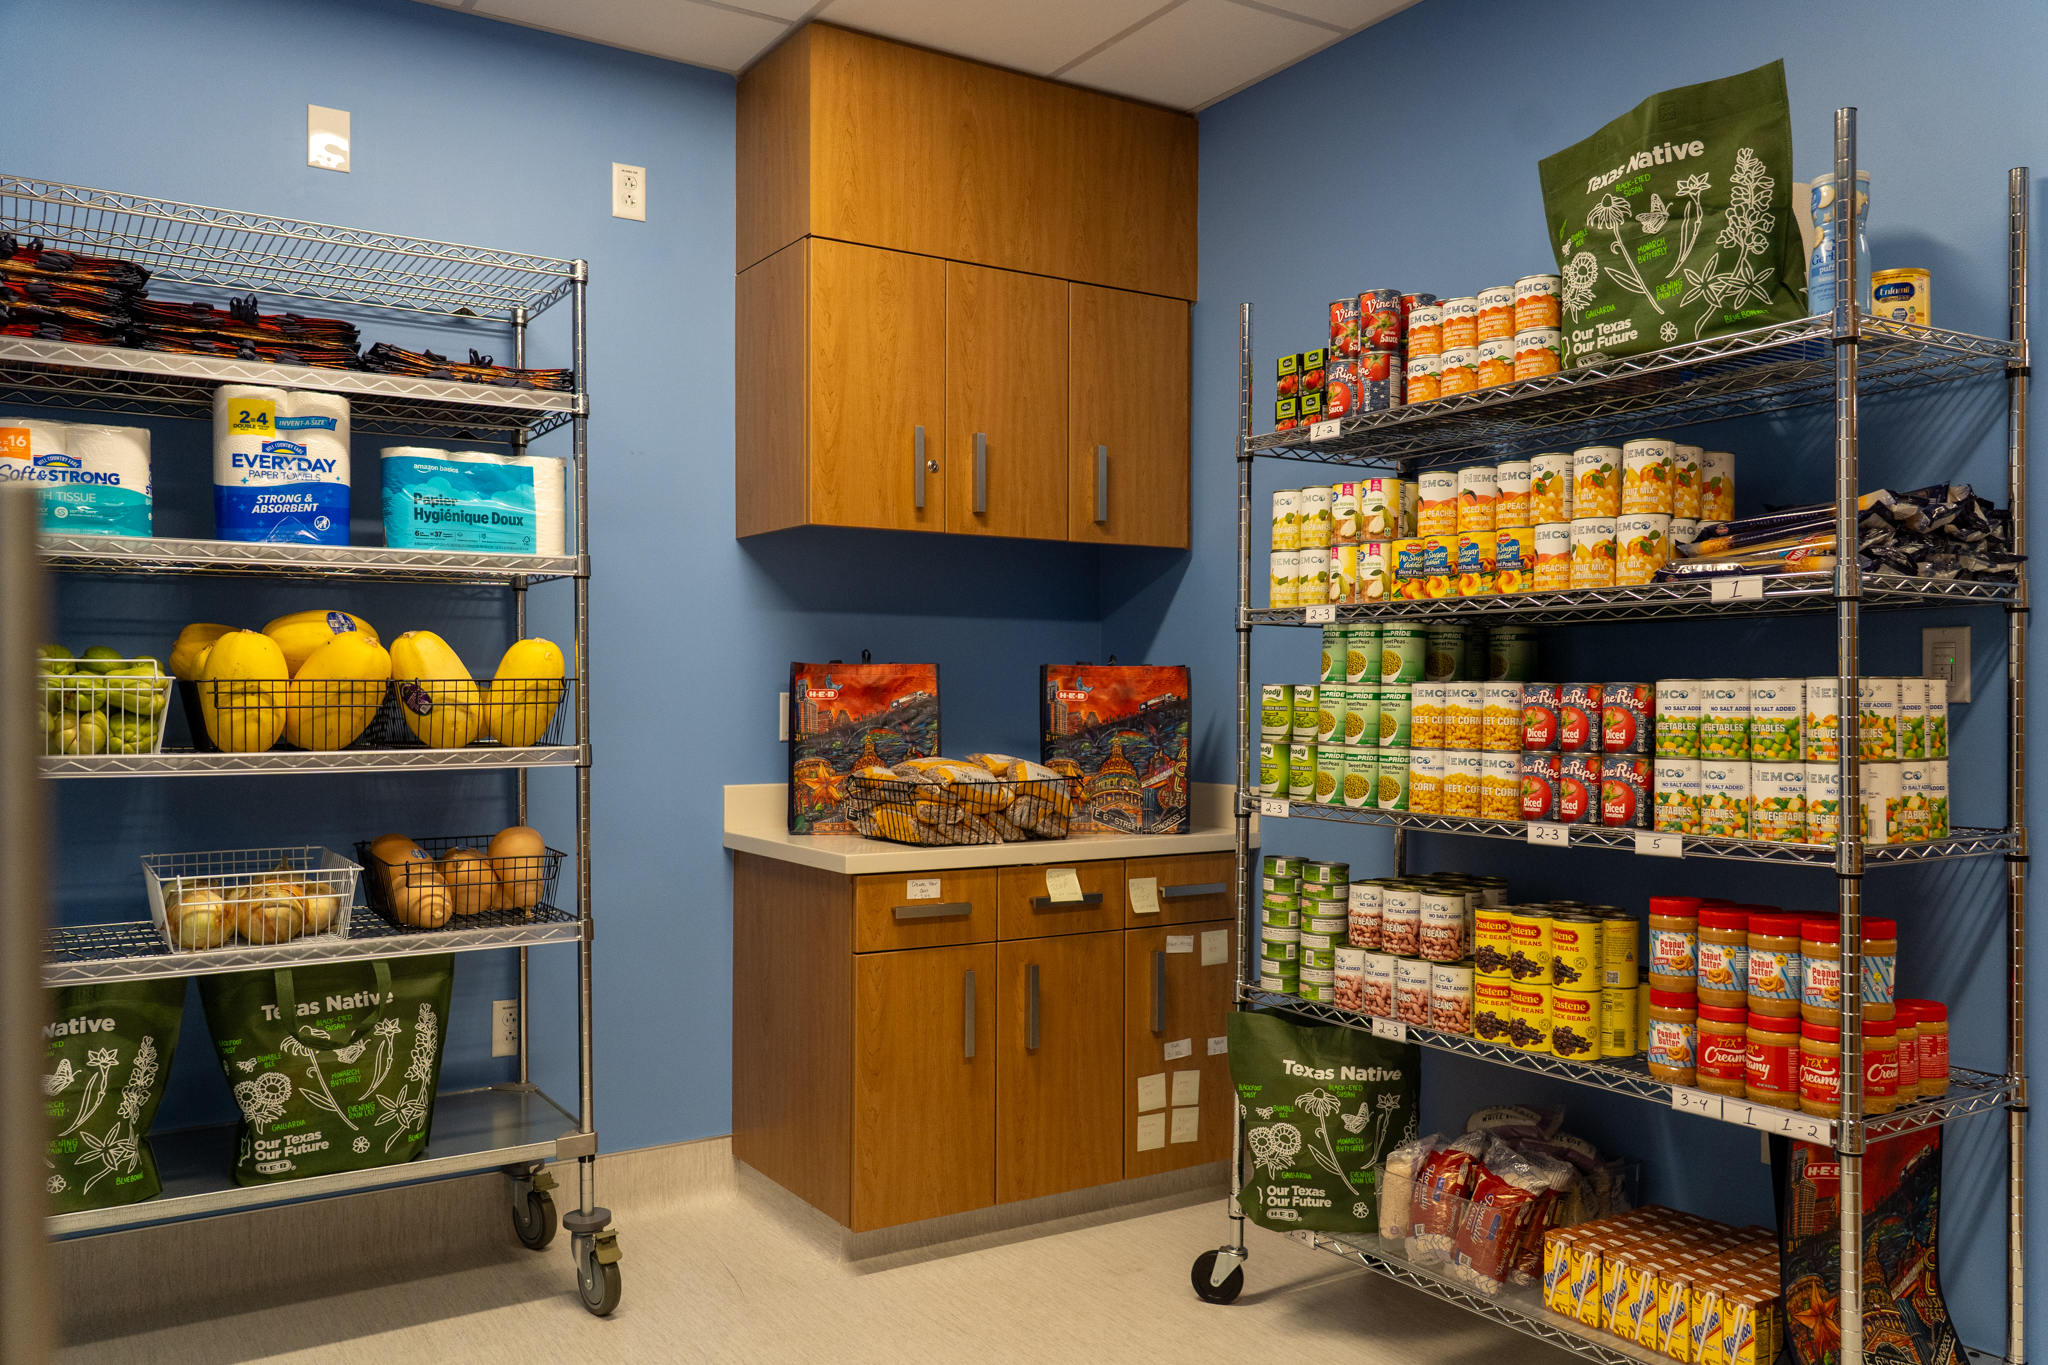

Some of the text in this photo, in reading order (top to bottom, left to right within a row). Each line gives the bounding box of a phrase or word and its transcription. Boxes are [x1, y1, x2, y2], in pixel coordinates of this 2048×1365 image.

[1585, 140, 1704, 195] Texas Native
[1615, 173, 1651, 192] BLACK-EYED
[1623, 184, 1643, 198] SUSAN
[1571, 228, 1588, 243] BUMBLE
[1637, 237, 1666, 255] MONARCH
[1637, 245, 1668, 264] BUTTERFLY
[1655, 278, 1683, 295] EVENING
[1879, 285, 1910, 296] Enfamil
[1655, 286, 1683, 301] RAIN LILY
[1366, 299, 1390, 314] Vine
[1522, 302, 1548, 311] MANDARIN
[1523, 308, 1549, 316] SEGMENTS
[1484, 319, 1508, 327] SEGMENTS
[1571, 319, 1631, 343] Our Texas
[1380, 334, 1398, 344] Sauce
[1596, 328, 1638, 351] Future
[1336, 366, 1358, 382] Ripe
[1328, 405, 1343, 414] Sauce
[279, 419, 325, 427] INVENT-A-SIZE
[266, 441, 304, 455] HILL COUNTRY FARE
[37, 458, 47, 466] HILL
[67, 457, 79, 467] FARE
[232, 453, 337, 473] EVERYDAY
[0, 464, 120, 485] Soft STRONG
[413, 463, 459, 474] amazon basics
[248, 469, 321, 482] PAPER TOWELS
[56, 491, 96, 503] TISSUE
[1624, 486, 1654, 496] FRUIT MIX
[256, 493, 313, 504] STRONG &
[413, 492, 458, 507] Papier
[251, 503, 319, 514] ABSORBENT
[1427, 510, 1456, 518] PEACHES
[1461, 506, 1480, 514] DICED
[414, 507, 524, 527] Hygiénique Doux
[1773, 515, 1797, 523] Quality
[1276, 526, 1298, 534] PEARS
[1308, 523, 1331, 531] PEARS
[1399, 554, 1407, 563] No
[1428, 550, 1447, 563] Sugar
[1404, 561, 1423, 569] Added
[1573, 564, 1590, 572] FRUIT
[1729, 580, 1743, 599] 1
[1262, 688, 1281, 697] Foody
[1570, 689, 1598, 709] Ripe
[1617, 689, 1645, 709] Ripe
[1457, 716, 1481, 725] CORN
[1497, 716, 1522, 726] CORN
[1527, 727, 1547, 738] Diced
[1562, 728, 1579, 739] Diced
[1606, 729, 1626, 740] Diced
[1164, 795, 1184, 806] FEST
[1114, 817, 1141, 831] STREET
[1152, 813, 1181, 832] CONGRESS
[1652, 838, 1662, 850] 5
[1476, 919, 1507, 931] Pastene
[1660, 938, 1685, 949] Peanut
[1661, 947, 1685, 957] Butter
[1701, 950, 1722, 962] Peanut
[1701, 958, 1722, 969] Butter
[1476, 984, 1509, 997] Pastene
[1553, 998, 1586, 1011] Pastene
[315, 1014, 353, 1027] BLACK-EYED
[41, 1016, 115, 1039] Native
[325, 1022, 346, 1032] SUSAN
[1717, 1037, 1737, 1049] TEX
[257, 1052, 282, 1063] BUMBLE
[1805, 1057, 1823, 1069] TEX
[264, 1060, 276, 1068] BEE
[1282, 1059, 1402, 1081] Texas Native
[331, 1068, 360, 1080] MONARCH
[330, 1075, 362, 1088] BUTTERFLY
[1238, 1084, 1263, 1092] BLACKFOOT
[347, 1102, 376, 1114] EVENING
[348, 1110, 364, 1120] RAIN
[1482, 1114, 1503, 1123] WHITE
[1743, 1106, 1757, 1126] 1
[272, 1119, 306, 1132] GAILLARDIA
[254, 1131, 322, 1151] Our Texas
[254, 1139, 330, 1161] Our Future
[1350, 1176, 1364, 1184] RAIN
[1291, 1185, 1325, 1197] Texas
[1420, 1164, 1436, 1210] Honestly
[1292, 1196, 1332, 1208] Future
